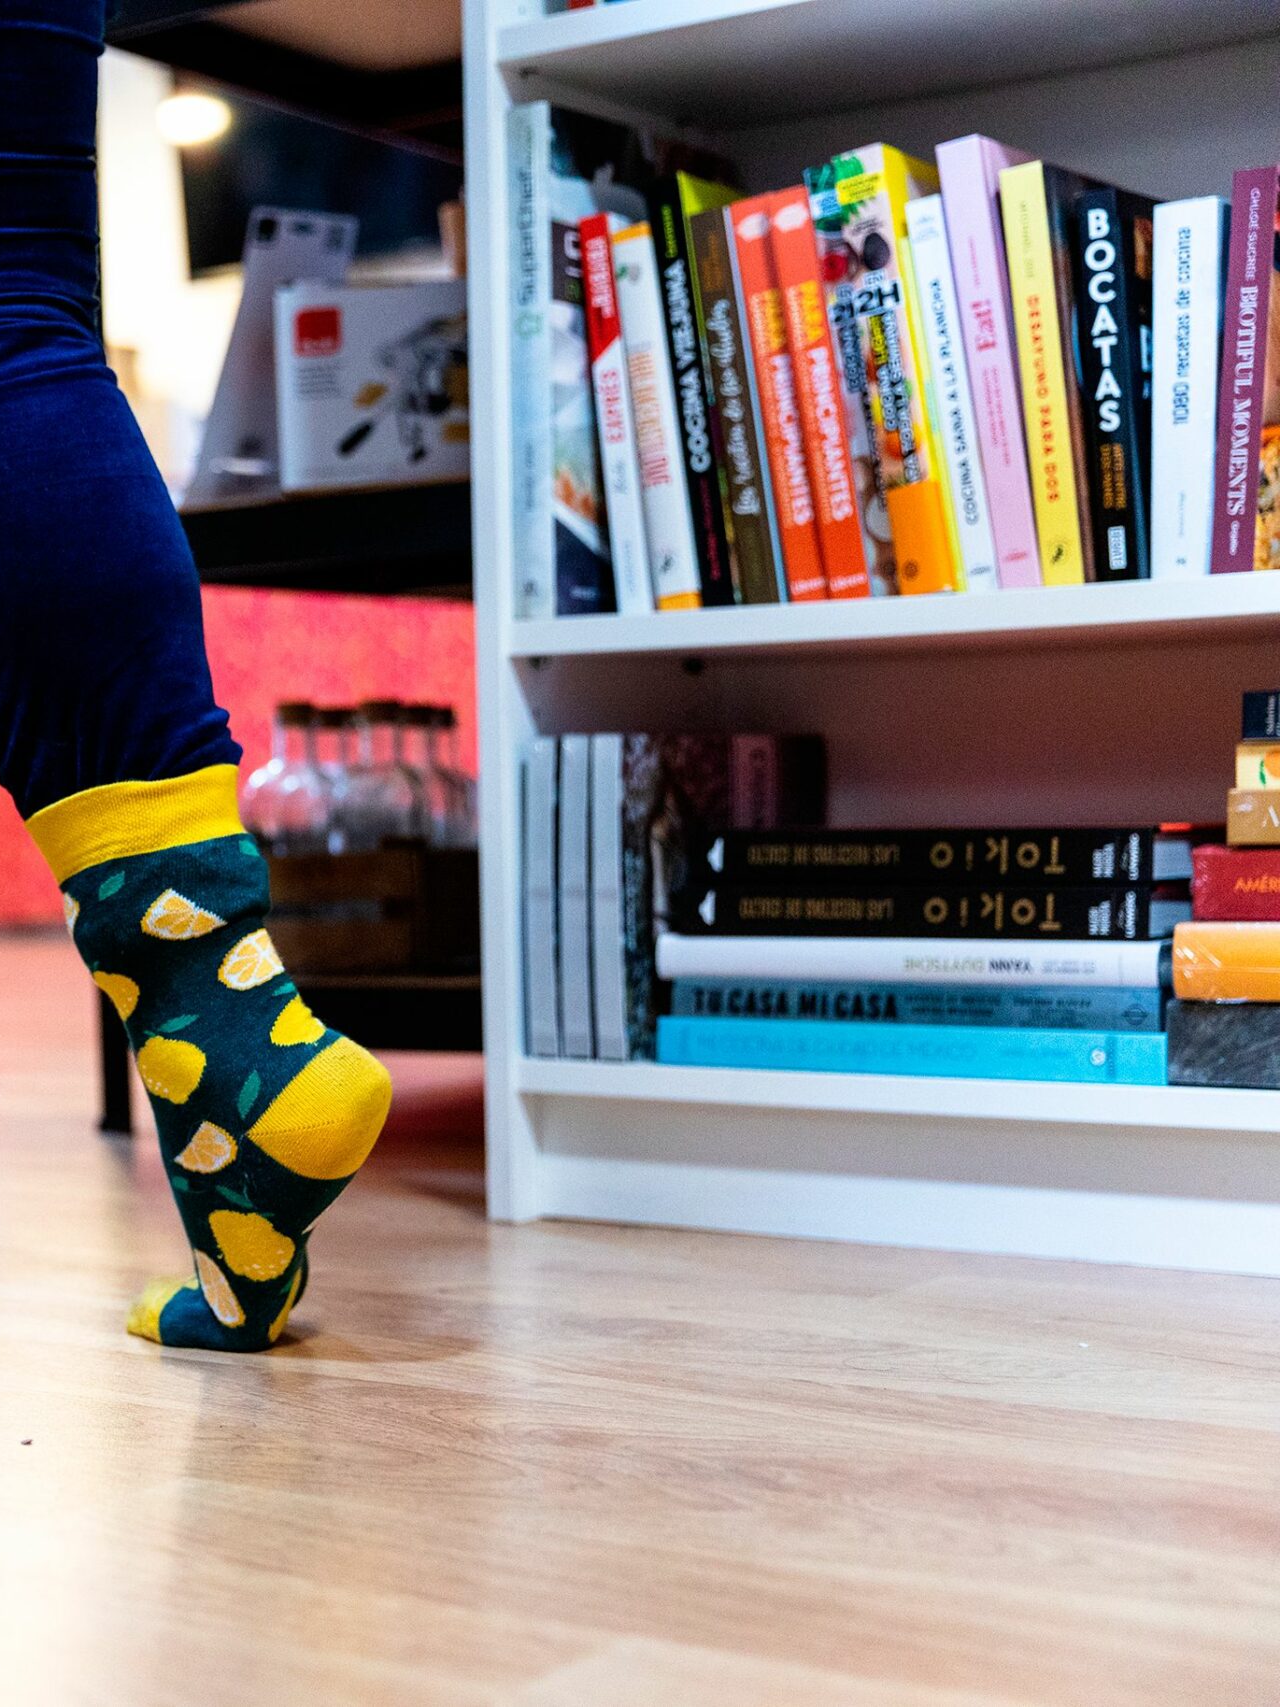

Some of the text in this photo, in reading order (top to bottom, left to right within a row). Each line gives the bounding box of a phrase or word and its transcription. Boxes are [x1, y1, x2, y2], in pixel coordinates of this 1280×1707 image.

[858, 282, 900, 313] 2H
[1084, 207, 1121, 432] BOCATAS
[1172, 227, 1190, 424] 1080 recetas de cocina
[939, 363, 956, 386] LA
[1027, 295, 1048, 397] DESAYUNO
[681, 361, 711, 473] COCINA
[1225, 285, 1259, 516] BIOTIFUL MOMENTS
[770, 354, 814, 525] PRINCIPIANTES
[808, 345, 852, 520] PRINCIPIANTES
[947, 406, 968, 455] SANA
[1038, 404, 1055, 456] PARA
[957, 459, 979, 524] COCINA
[1043, 462, 1060, 503] DOS
[929, 835, 1065, 875] Tokio
[923, 892, 1062, 931] Tokio
[694, 987, 721, 1014] TU
[727, 988, 789, 1016] CASA
[798, 991, 827, 1018] MI
[834, 991, 898, 1019] CASA
